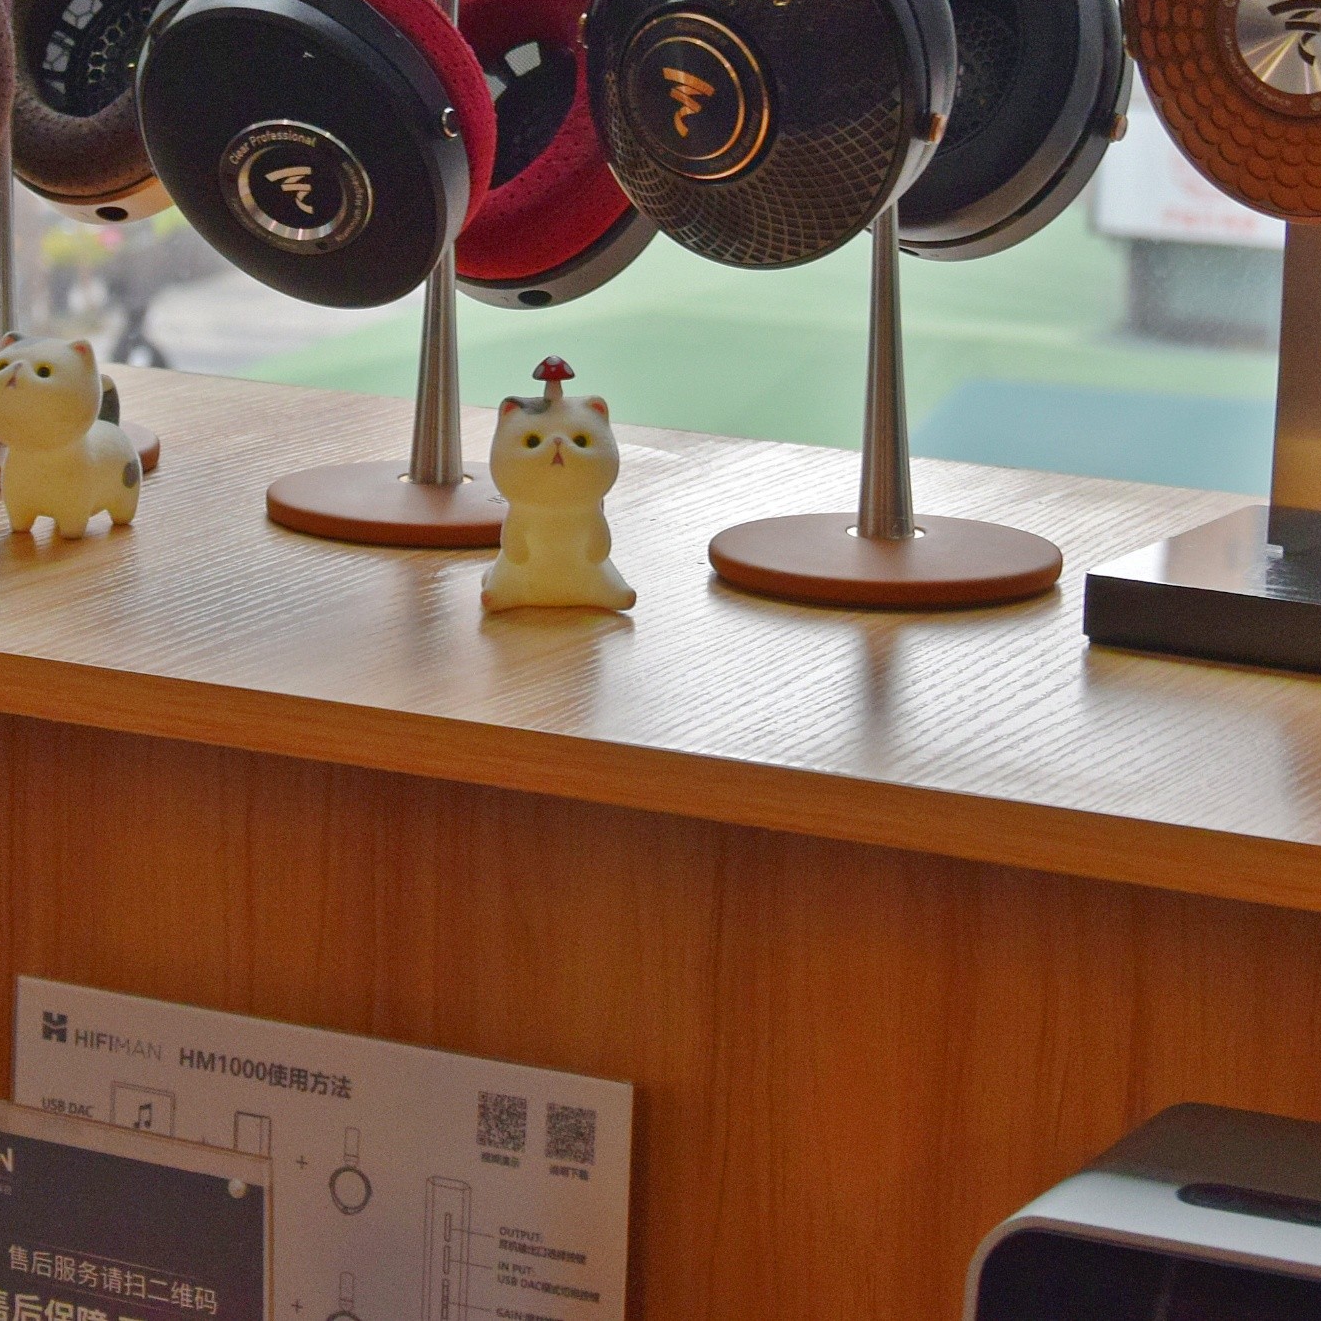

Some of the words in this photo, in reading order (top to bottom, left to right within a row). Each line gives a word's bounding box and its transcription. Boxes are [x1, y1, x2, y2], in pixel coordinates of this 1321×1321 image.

[229, 142, 251, 165] Clear
[248, 130, 317, 147] Professional
[74, 1027, 162, 1061] HIFIMAN
[179, 1045, 352, 1100] HM1000使用方法
[41, 1095, 66, 1114] USB
[67, 1100, 94, 1119] DAC
[7, 1244, 218, 1315] 售后服务请扫二维码
